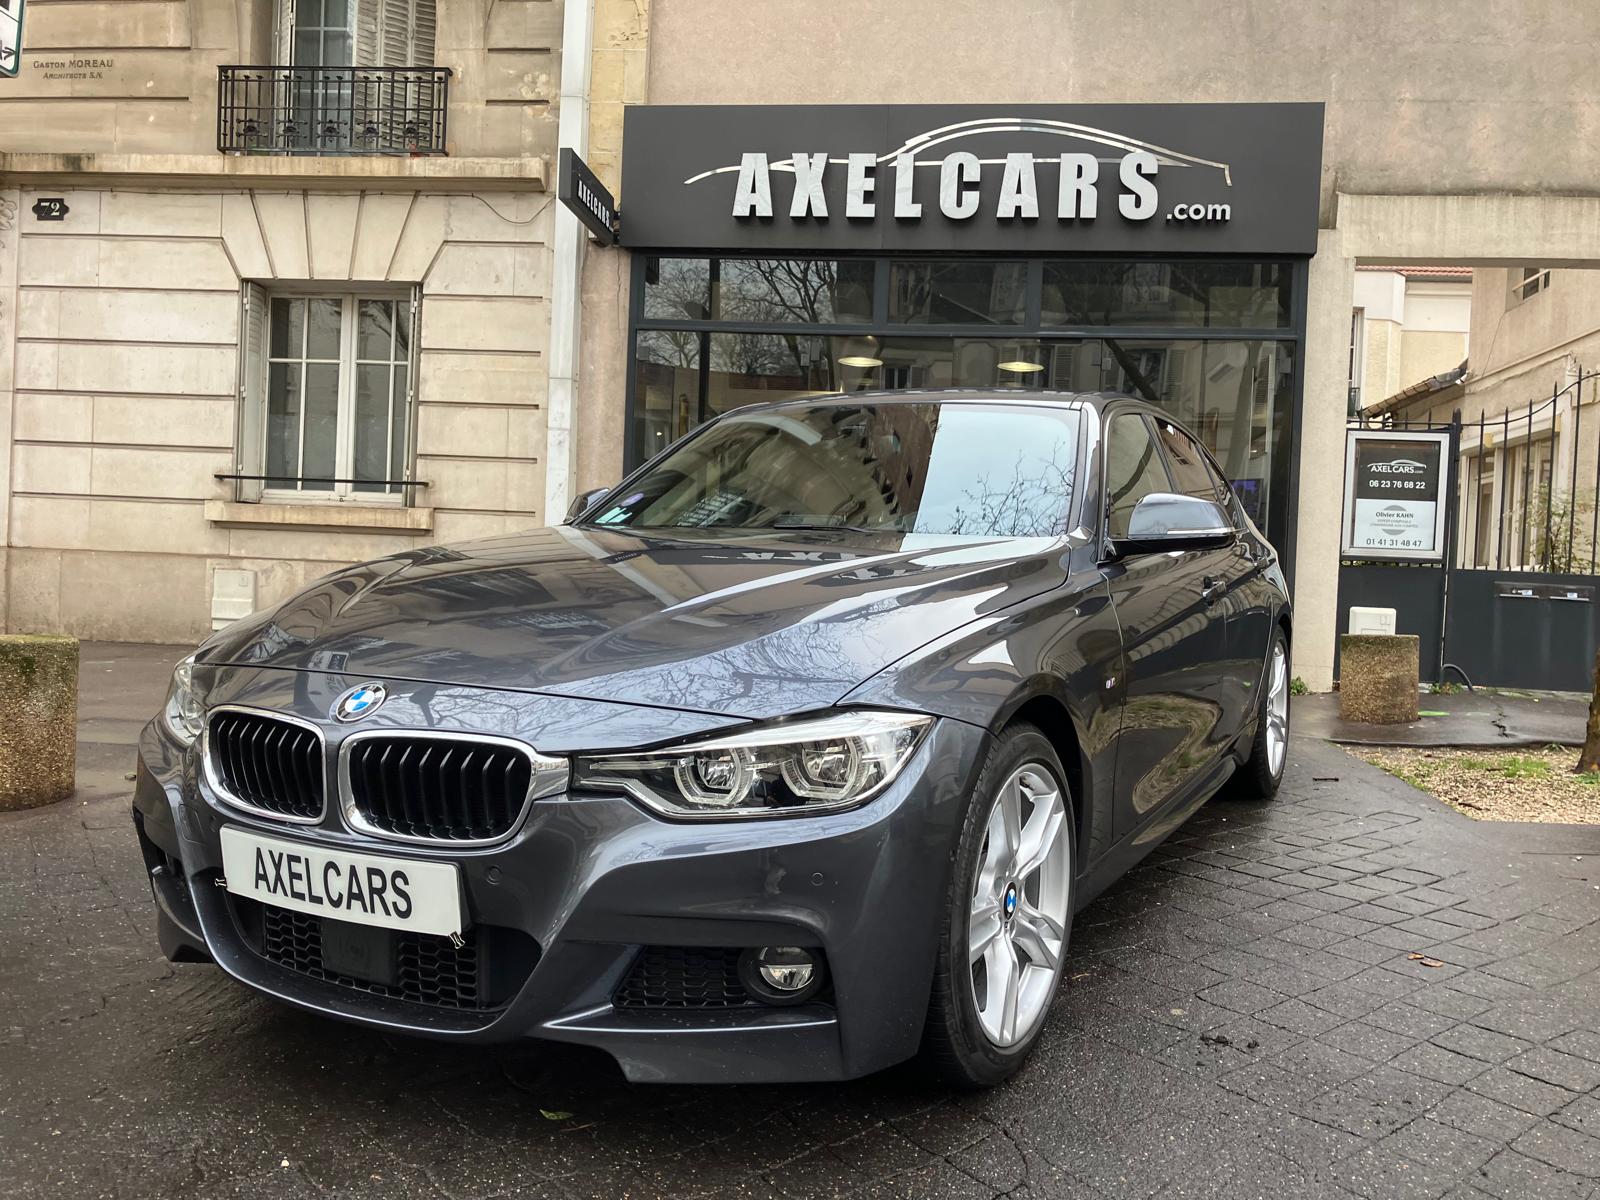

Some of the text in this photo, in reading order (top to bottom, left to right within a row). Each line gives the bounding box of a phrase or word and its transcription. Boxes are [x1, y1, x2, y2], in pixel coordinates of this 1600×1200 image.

[69, 59, 113, 68] MOREAU
[731, 151, 1159, 221] AXELCARS
[40, 202, 60, 216] 72
[577, 179, 610, 228] AXELCARS
[1369, 480, 1379, 488] 06
[1380, 480, 1391, 488] 23
[1404, 481, 1414, 489] 68
[1415, 481, 1426, 489] 22
[1377, 538, 1387, 546] 41
[254, 846, 413, 920] AXELCARS
